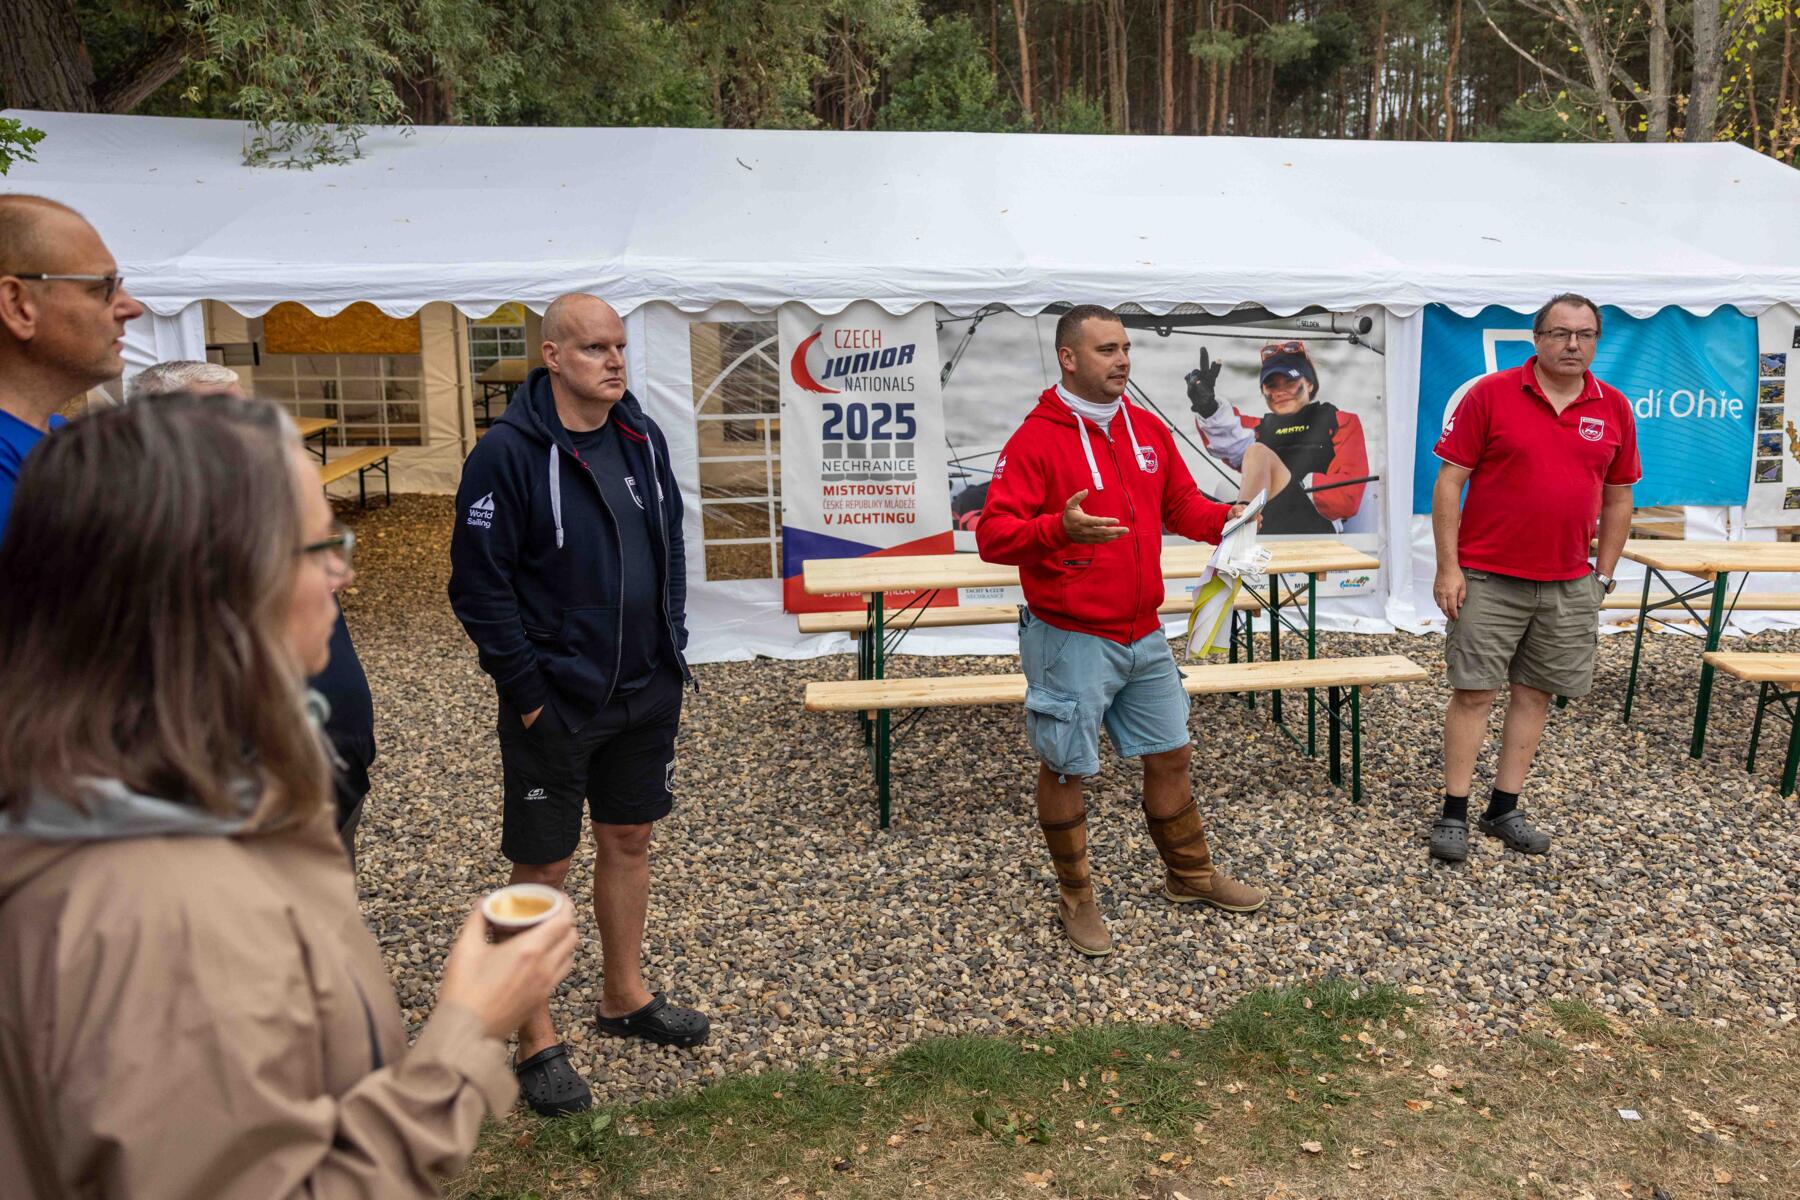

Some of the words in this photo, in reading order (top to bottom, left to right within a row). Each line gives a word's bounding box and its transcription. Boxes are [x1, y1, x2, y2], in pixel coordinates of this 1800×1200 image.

[834, 329, 882, 349] CZECH
[821, 343, 916, 380] JUNIOR
[844, 376, 915, 392] NATIONALS
[1669, 388, 1744, 420] Ohře
[822, 402, 917, 441] 2025
[822, 459, 917, 472] NECHRANICE
[823, 482, 916, 496] MISTROVSTVÍ
[823, 498, 843, 510] ČESKÉ
[845, 498, 882, 509] REPUBLIKY
[885, 497, 917, 509] MLÁDEŽE
[469, 508, 494, 519] World
[823, 513, 833, 525] V
[837, 512, 916, 525] JACHTINGU
[467, 517, 492, 529] Sailing
